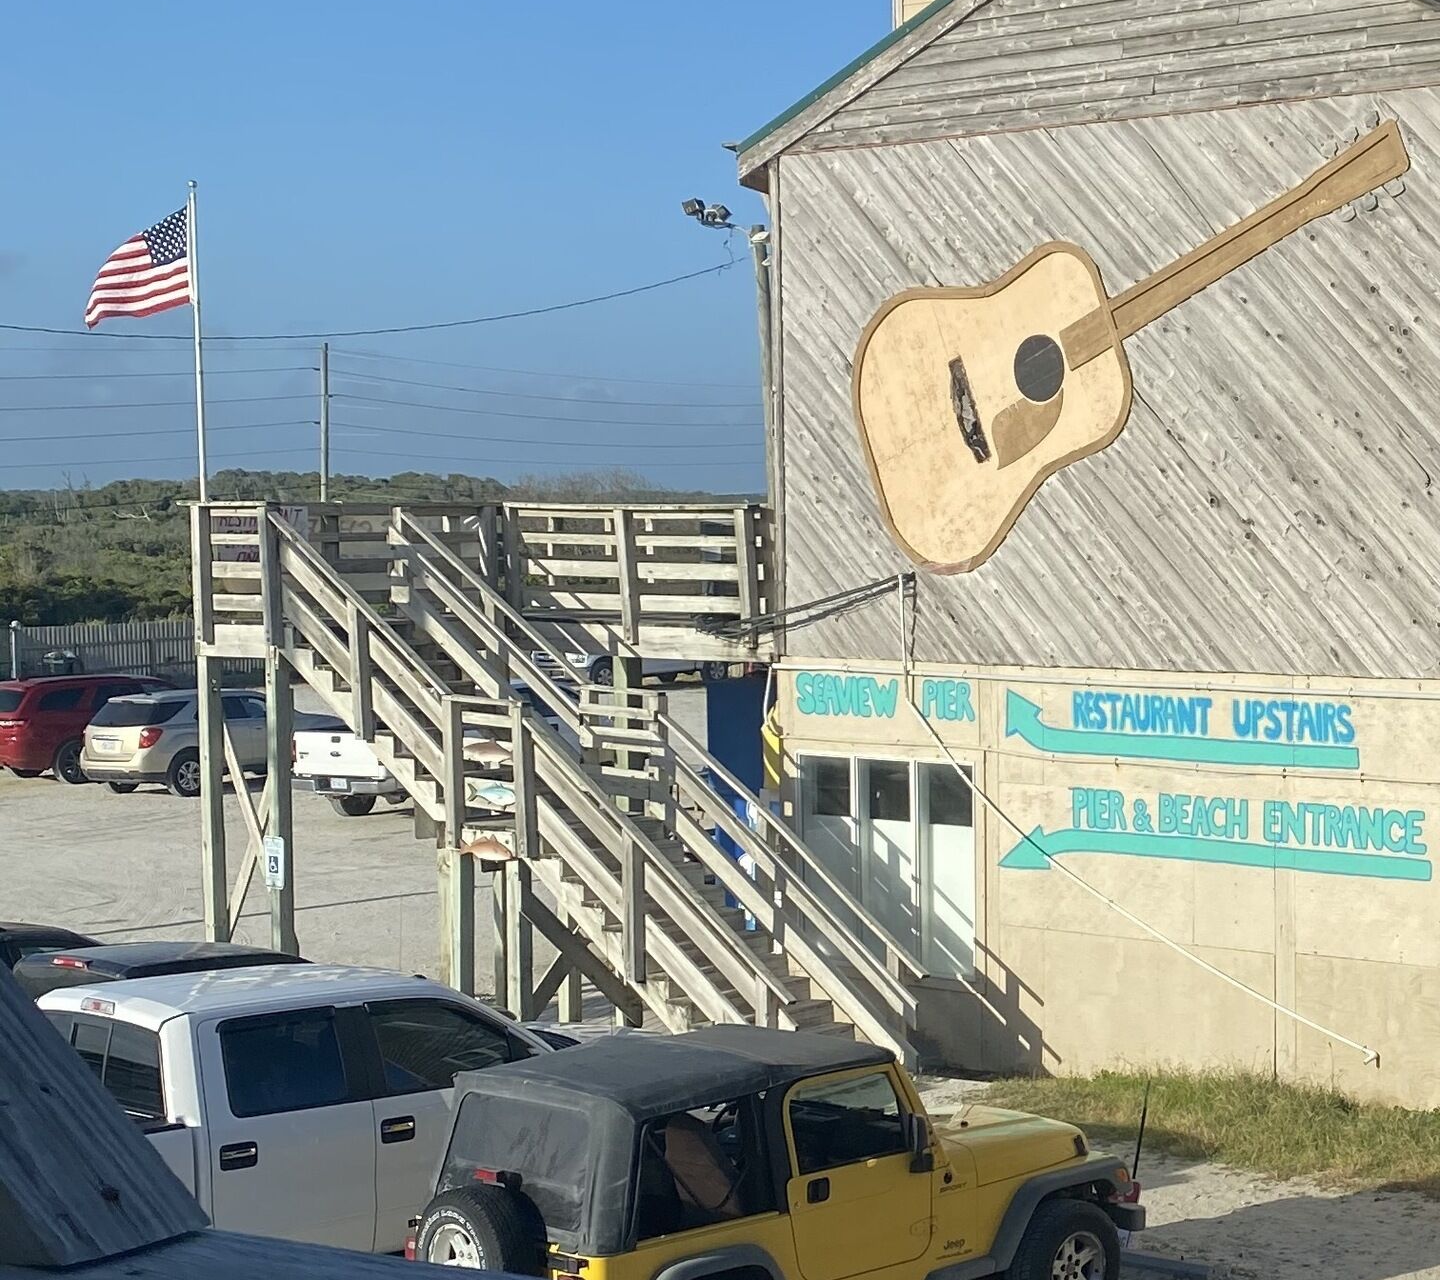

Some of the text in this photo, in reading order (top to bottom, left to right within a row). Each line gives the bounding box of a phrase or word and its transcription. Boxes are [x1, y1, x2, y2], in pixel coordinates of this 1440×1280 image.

[796, 672, 976, 722] SEAVIEW PIER
[1072, 690, 1357, 743] RESTAURANT UPSTAIRS
[1071, 787, 1428, 855] PIER & BEACH ENTRANCE
[943, 1238, 966, 1251] Jeep
